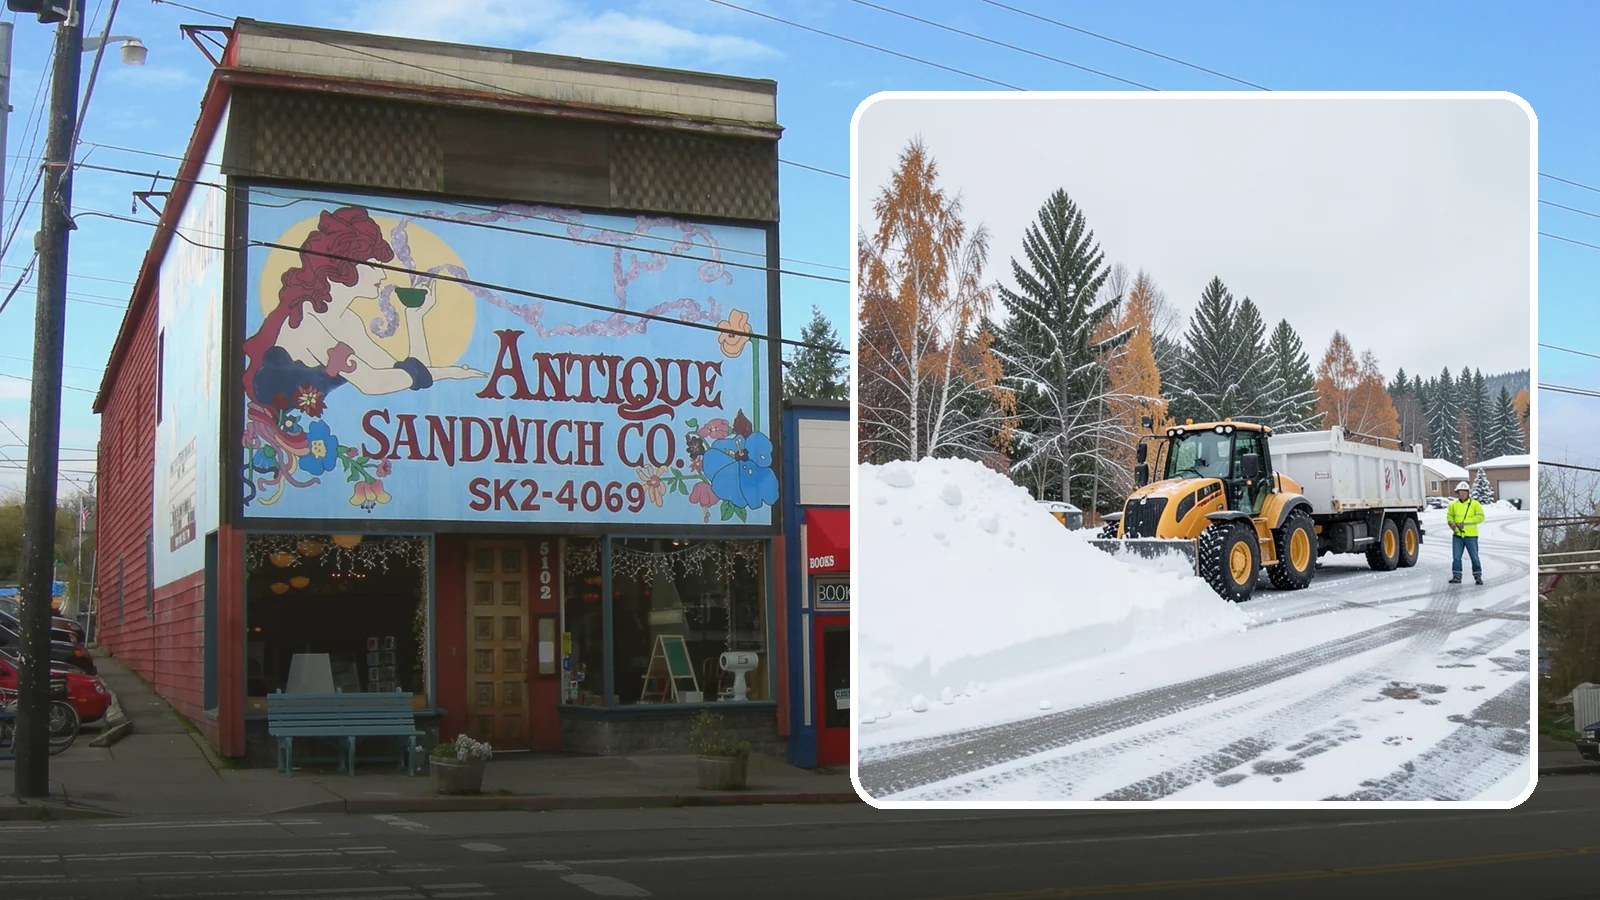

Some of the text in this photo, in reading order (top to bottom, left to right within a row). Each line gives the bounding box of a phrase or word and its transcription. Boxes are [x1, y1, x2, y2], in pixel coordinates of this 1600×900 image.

[476, 329, 723, 420] ANTIQUE
[361, 408, 684, 468] SANDWICH CO.
[468, 477, 645, 513] SK2-4069
[540, 542, 551, 599] 5102
[809, 555, 835, 569] BOOKS
